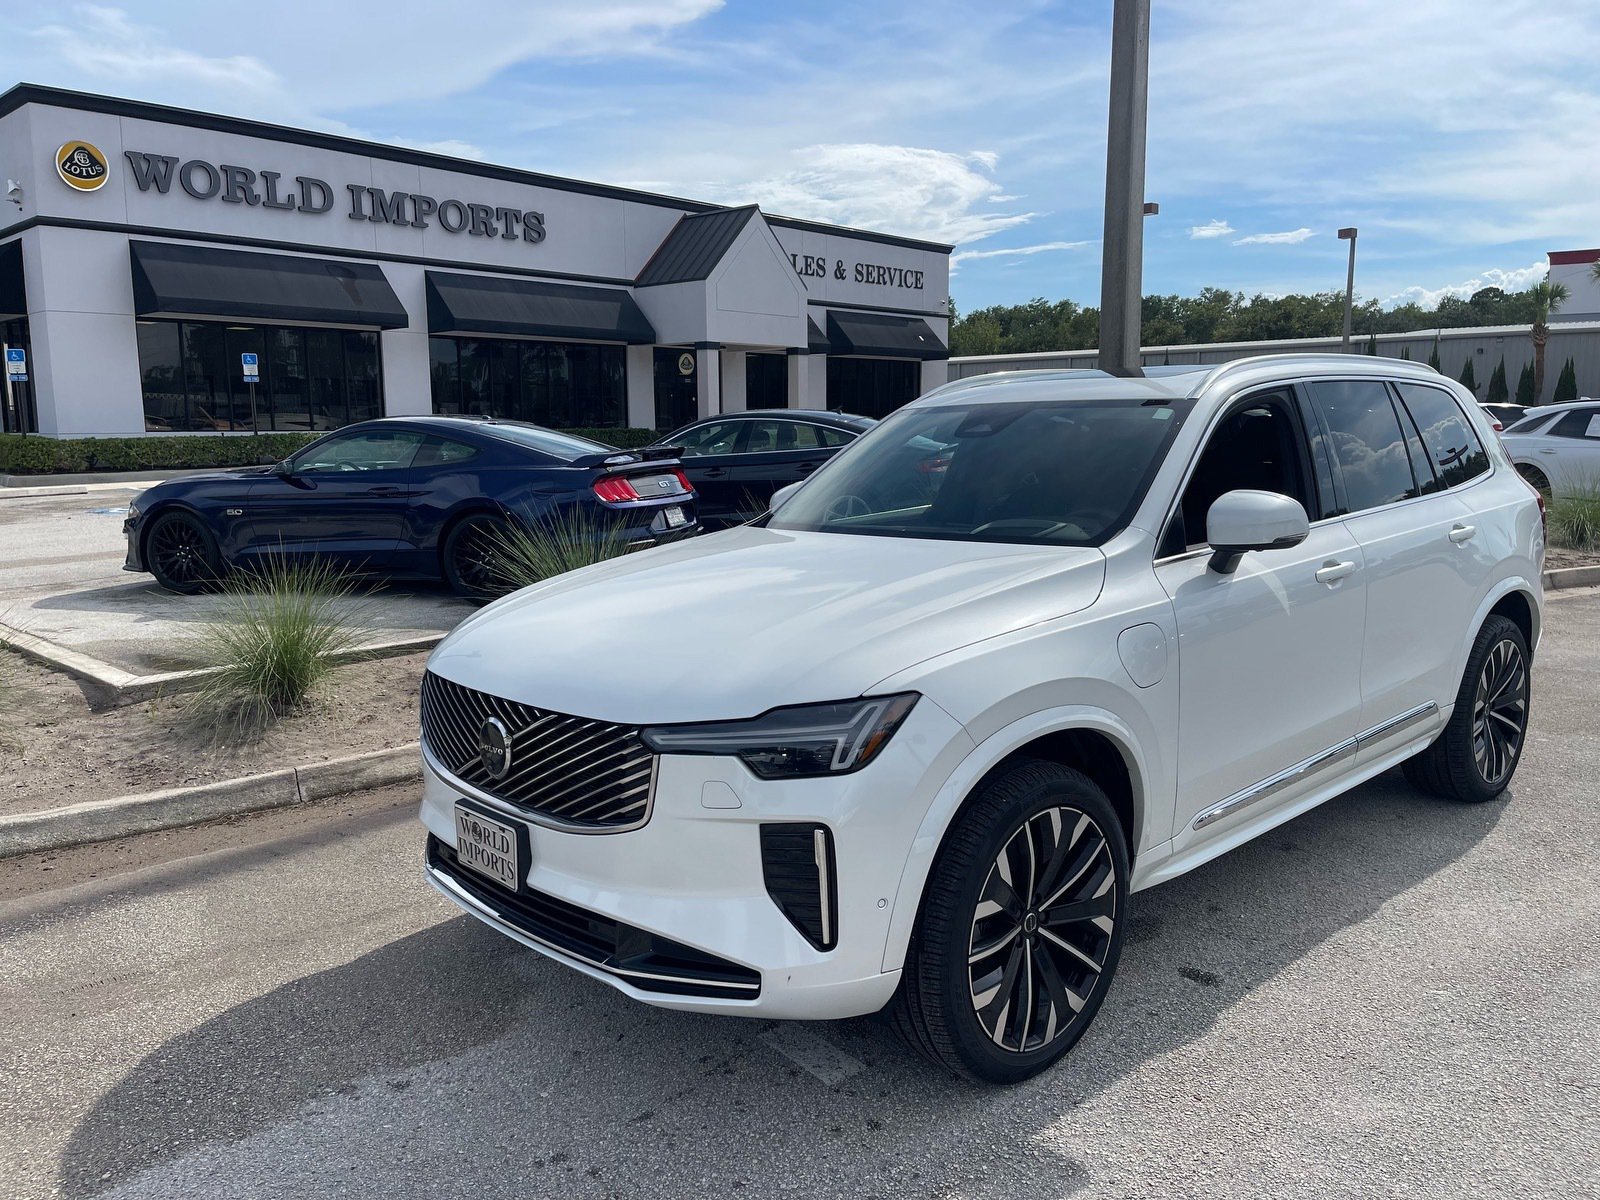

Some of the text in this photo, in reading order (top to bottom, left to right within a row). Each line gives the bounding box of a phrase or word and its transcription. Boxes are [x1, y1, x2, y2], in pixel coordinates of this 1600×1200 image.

[64, 162, 103, 176] LOTUS
[124, 150, 547, 243] WORLD IMPORTS
[791, 253, 924, 290] LES & SERVICE
[658, 480, 670, 488] GT
[460, 816, 509, 854] WORLD
[458, 836, 514, 880] IMPORTS
